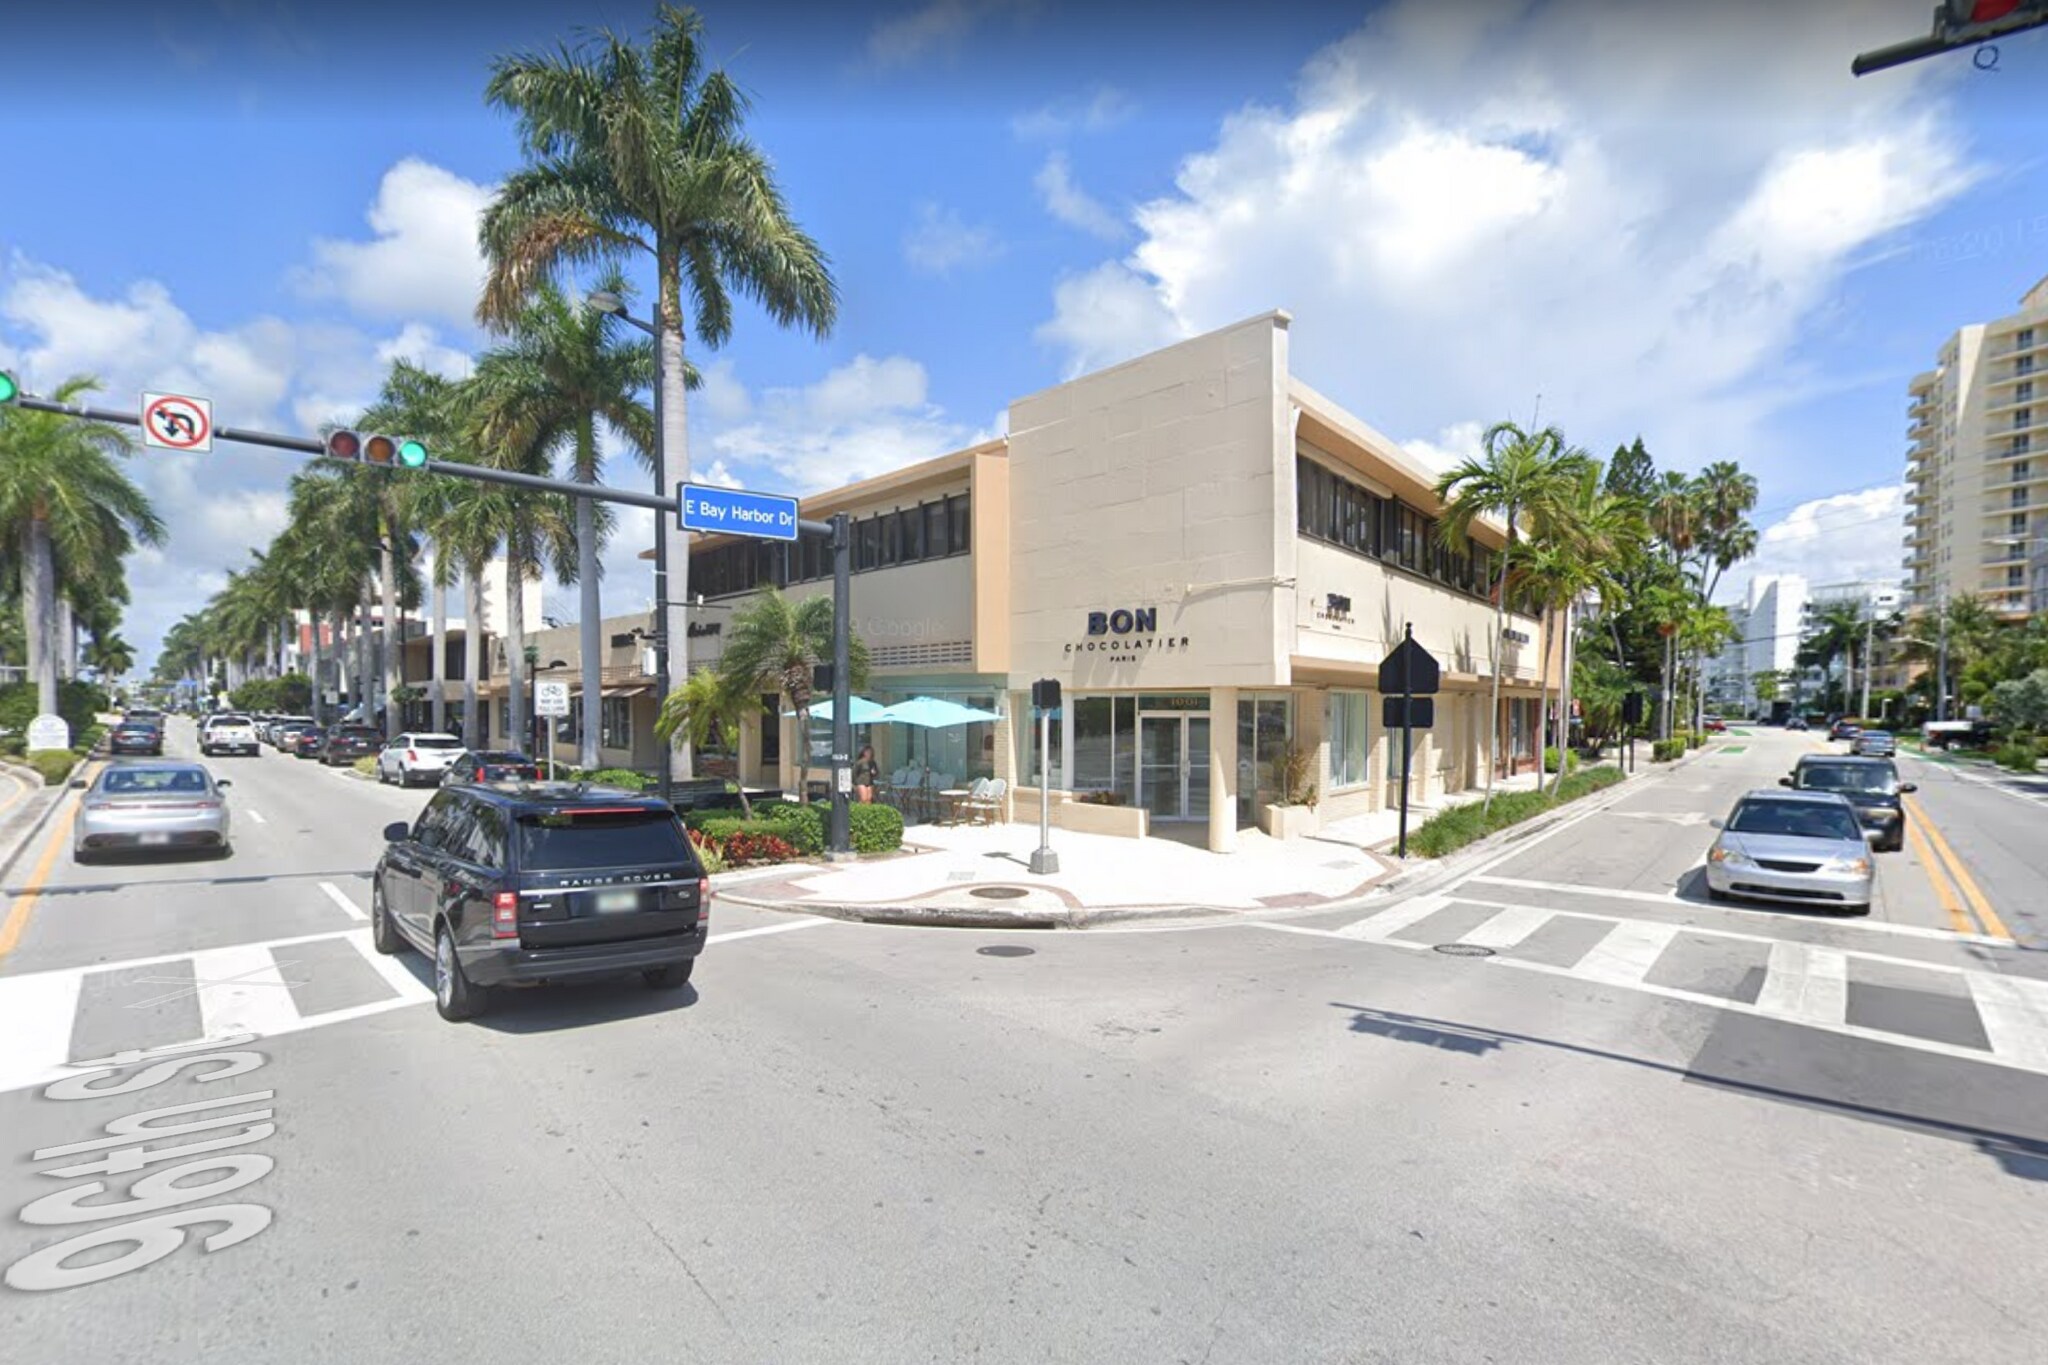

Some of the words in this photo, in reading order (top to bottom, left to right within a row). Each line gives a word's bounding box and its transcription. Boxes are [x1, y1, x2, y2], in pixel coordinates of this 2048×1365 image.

[686, 500, 694, 514] E
[701, 501, 726, 521] Bay
[732, 506, 774, 524] Harbor
[779, 511, 794, 526] Dr
[1088, 607, 1157, 635] BON
[1064, 637, 1189, 652] CHOCOLATIER
[560, 877, 613, 886] RANGE
[623, 873, 671, 881] ROVER
